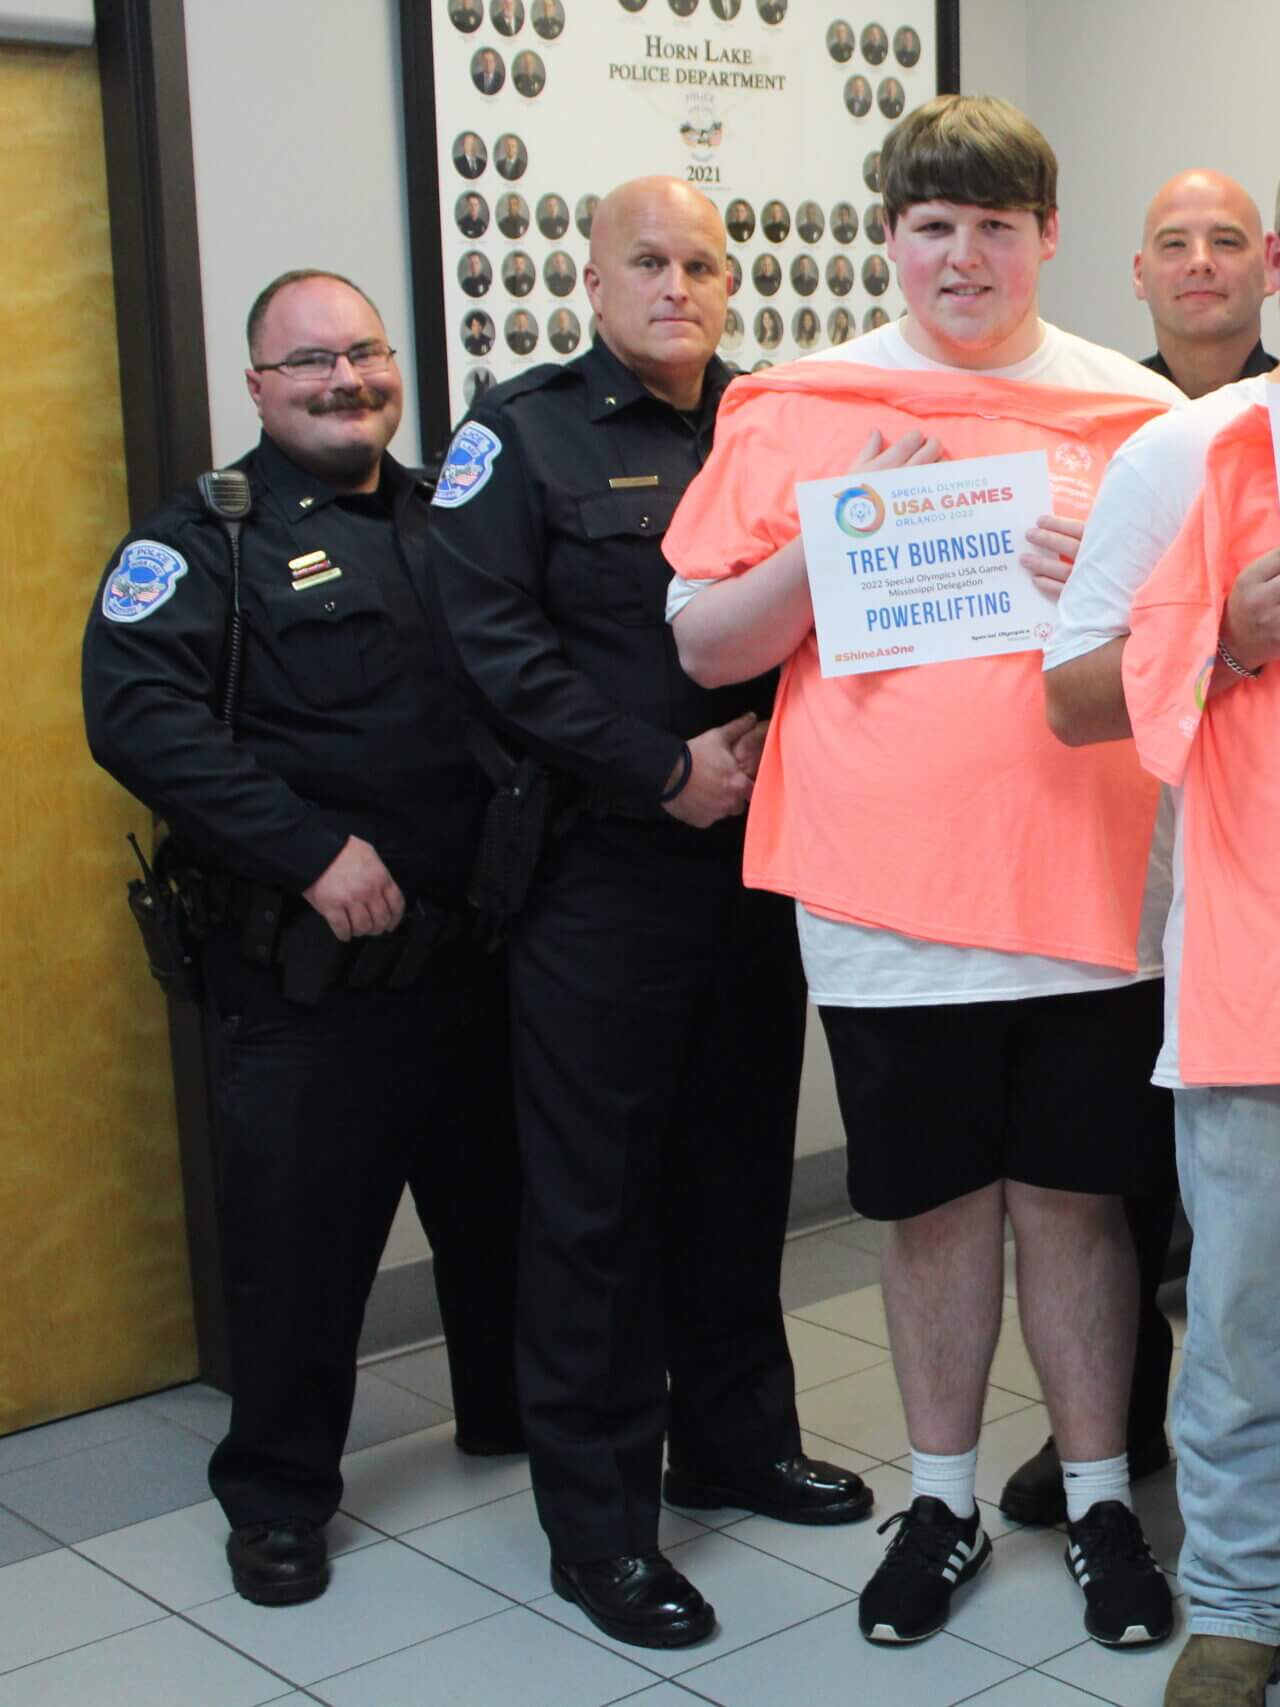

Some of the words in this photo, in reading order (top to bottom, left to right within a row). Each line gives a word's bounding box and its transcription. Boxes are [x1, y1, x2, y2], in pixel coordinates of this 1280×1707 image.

[609, 63, 671, 83] POLICE
[676, 68, 787, 91] DEPARTMENT
[687, 165, 721, 182] 2021
[891, 486, 934, 498] SPECIAL
[936, 478, 989, 492] OLYMPICS
[893, 498, 935, 516] USA
[941, 486, 1014, 509] GAMES
[895, 513, 946, 527] ORLANDO
[950, 509, 975, 520] 2022
[847, 544, 900, 575] TREY
[908, 529, 1015, 567] BURNSIDE
[861, 580, 883, 591] 2022
[885, 576, 915, 588] Special
[916, 571, 957, 584] Olympics
[958, 567, 977, 577] USA
[978, 564, 1008, 575] Games
[888, 584, 934, 597] Mississippi
[937, 578, 983, 592] Delegation
[866, 591, 1011, 632] POWERLIFTING
[835, 645, 915, 662] #ShineAsOne
